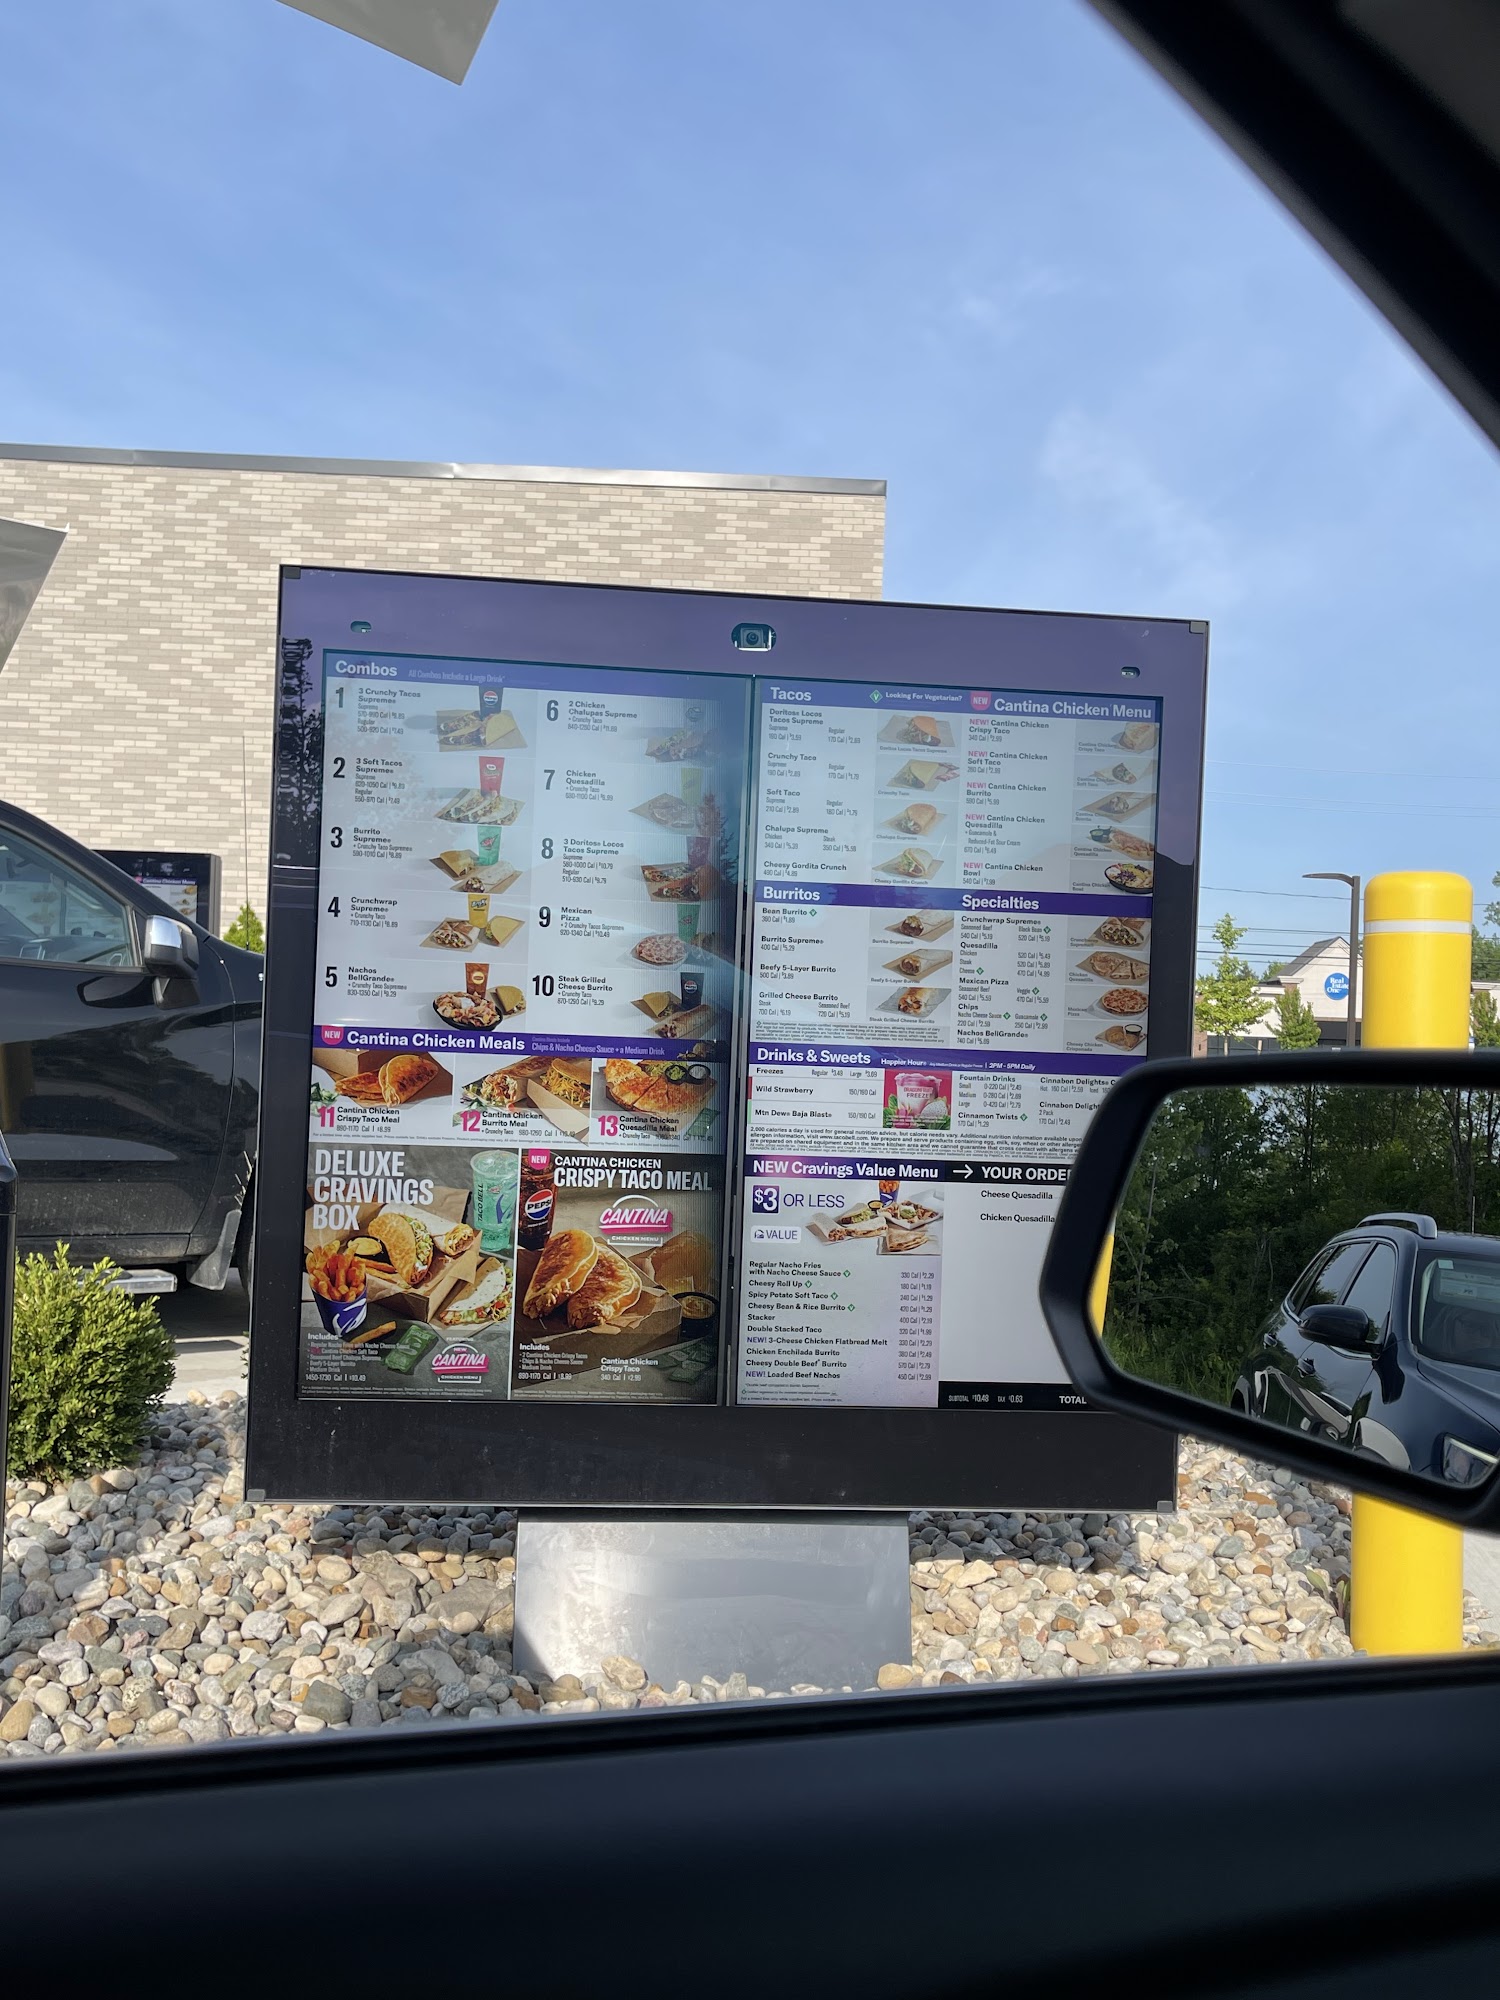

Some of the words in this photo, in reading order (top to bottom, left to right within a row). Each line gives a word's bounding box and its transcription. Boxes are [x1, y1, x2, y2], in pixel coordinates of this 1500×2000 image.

[335, 660, 398, 677] Combos
[335, 687, 344, 708] 1
[365, 688, 397, 698] Crunchy
[399, 690, 421, 698] Tacos
[770, 687, 812, 701] Tacos
[885, 692, 911, 700] Looking
[924, 693, 963, 703] Vegetarian?
[575, 701, 605, 709] Chicken
[994, 698, 1049, 714] Cantina
[1052, 701, 1109, 717] Chicken
[1112, 704, 1152, 719] Menu
[546, 699, 559, 722] 6
[568, 709, 603, 717] Chalupas
[605, 711, 638, 719] Supreme
[990, 719, 1019, 728] Cantina
[1020, 720, 1050, 729] Chicken
[969, 726, 992, 735] Crispy
[768, 753, 799, 761] Crunchy
[362, 758, 379, 766] Soft
[381, 759, 403, 767] Tacos
[333, 757, 345, 779] 2
[566, 770, 597, 778] Chicken
[544, 769, 555, 790] 7
[566, 778, 605, 786] Quesadilla
[765, 825, 795, 833] Chalupa
[797, 826, 829, 834] Supreme
[965, 821, 1003, 830] Quesadilla
[353, 827, 381, 835] Burrito
[330, 826, 343, 848] 3
[541, 838, 554, 859] 8
[602, 840, 624, 848] Locos
[563, 846, 585, 854] Tacos
[586, 847, 619, 855] Supreme
[764, 861, 790, 870] Cheesy
[792, 862, 819, 870] Gordita
[820, 863, 847, 871] Crunch
[763, 886, 821, 901] Burritos
[351, 897, 398, 906] Crunchwrap
[961, 894, 1040, 911] Specialties
[327, 897, 341, 917] 4
[561, 906, 592, 915] Mexican
[782, 908, 808, 916] Burrito
[539, 906, 551, 928] 9
[961, 915, 1005, 925] Crunchwrap
[348, 966, 377, 974] Nachos
[760, 964, 781, 972] Beefy
[782, 964, 810, 973] 5-Layer
[811, 965, 836, 973] Burrito
[325, 966, 337, 987] 5
[558, 975, 579, 983] Steak
[581, 976, 606, 984] Grilled
[959, 977, 989, 985] Mexican
[990, 978, 1009, 986] Pizza
[532, 975, 554, 996] 10
[587, 984, 613, 992] Burrito
[759, 992, 783, 1000] Grilled
[785, 992, 812, 1000] Cheese
[813, 993, 839, 1001] Burrito
[958, 1003, 979, 1011] Chips
[324, 1031, 340, 1039] NEW
[347, 1031, 409, 1046] Cantina
[413, 1033, 476, 1049] Chicken
[479, 1035, 525, 1051] Meals
[757, 1048, 804, 1062] Drinks
[806, 1050, 817, 1062] &
[820, 1050, 871, 1065] Sweets
[881, 1058, 906, 1066] Happier
[1040, 1077, 1075, 1085] Cinnabon
[773, 1086, 814, 1096] Strawberry
[318, 1106, 335, 1128] 11
[337, 1115, 361, 1124] Crispy
[460, 1110, 481, 1132] 12
[598, 1116, 618, 1136] 13
[619, 1124, 659, 1132] Quesadilla
[315, 1149, 405, 1177] DELUXE
[531, 1155, 547, 1164] NEW
[555, 1156, 607, 1168] CANTINA
[609, 1157, 661, 1169] CHICKEN
[753, 1159, 789, 1173] NEW
[791, 1161, 853, 1178] Cravings
[856, 1163, 896, 1177] Value
[899, 1165, 939, 1178] Menu
[981, 1166, 1022, 1179] YOUR
[1025, 1168, 1070, 1181] ORDE
[553, 1168, 617, 1188] CRISPY
[618, 1169, 663, 1190] TACO
[666, 1171, 713, 1191] MEAL
[314, 1177, 434, 1205] CRAVINGS
[981, 1190, 1010, 1198] Cheese
[1011, 1191, 1053, 1200] Quesadilla
[754, 1188, 778, 1212] $3
[783, 1193, 804, 1207] OR
[808, 1194, 845, 1208] LESS
[313, 1204, 360, 1231] BOX
[600, 1208, 669, 1224] CANTINA
[980, 1213, 1012, 1221] Chicken
[1013, 1214, 1056, 1223] Quesadilla
[766, 1230, 797, 1240] VALUE
[749, 1261, 778, 1269] Regular
[748, 1280, 776, 1288] Cheesy
[748, 1291, 769, 1300] Spicy
[748, 1303, 775, 1311] Cheesy
[308, 1333, 339, 1341] Includes
[768, 1337, 803, 1345] 3-Cheese
[835, 1338, 870, 1346] Flatbread
[519, 1343, 550, 1351] Includes
[777, 1348, 813, 1356] Enchilada
[432, 1353, 486, 1366] CANTINA
[629, 1358, 659, 1366] Chicken
[600, 1365, 622, 1373] Crispy
[1059, 1395, 1087, 1405] TOTAL
